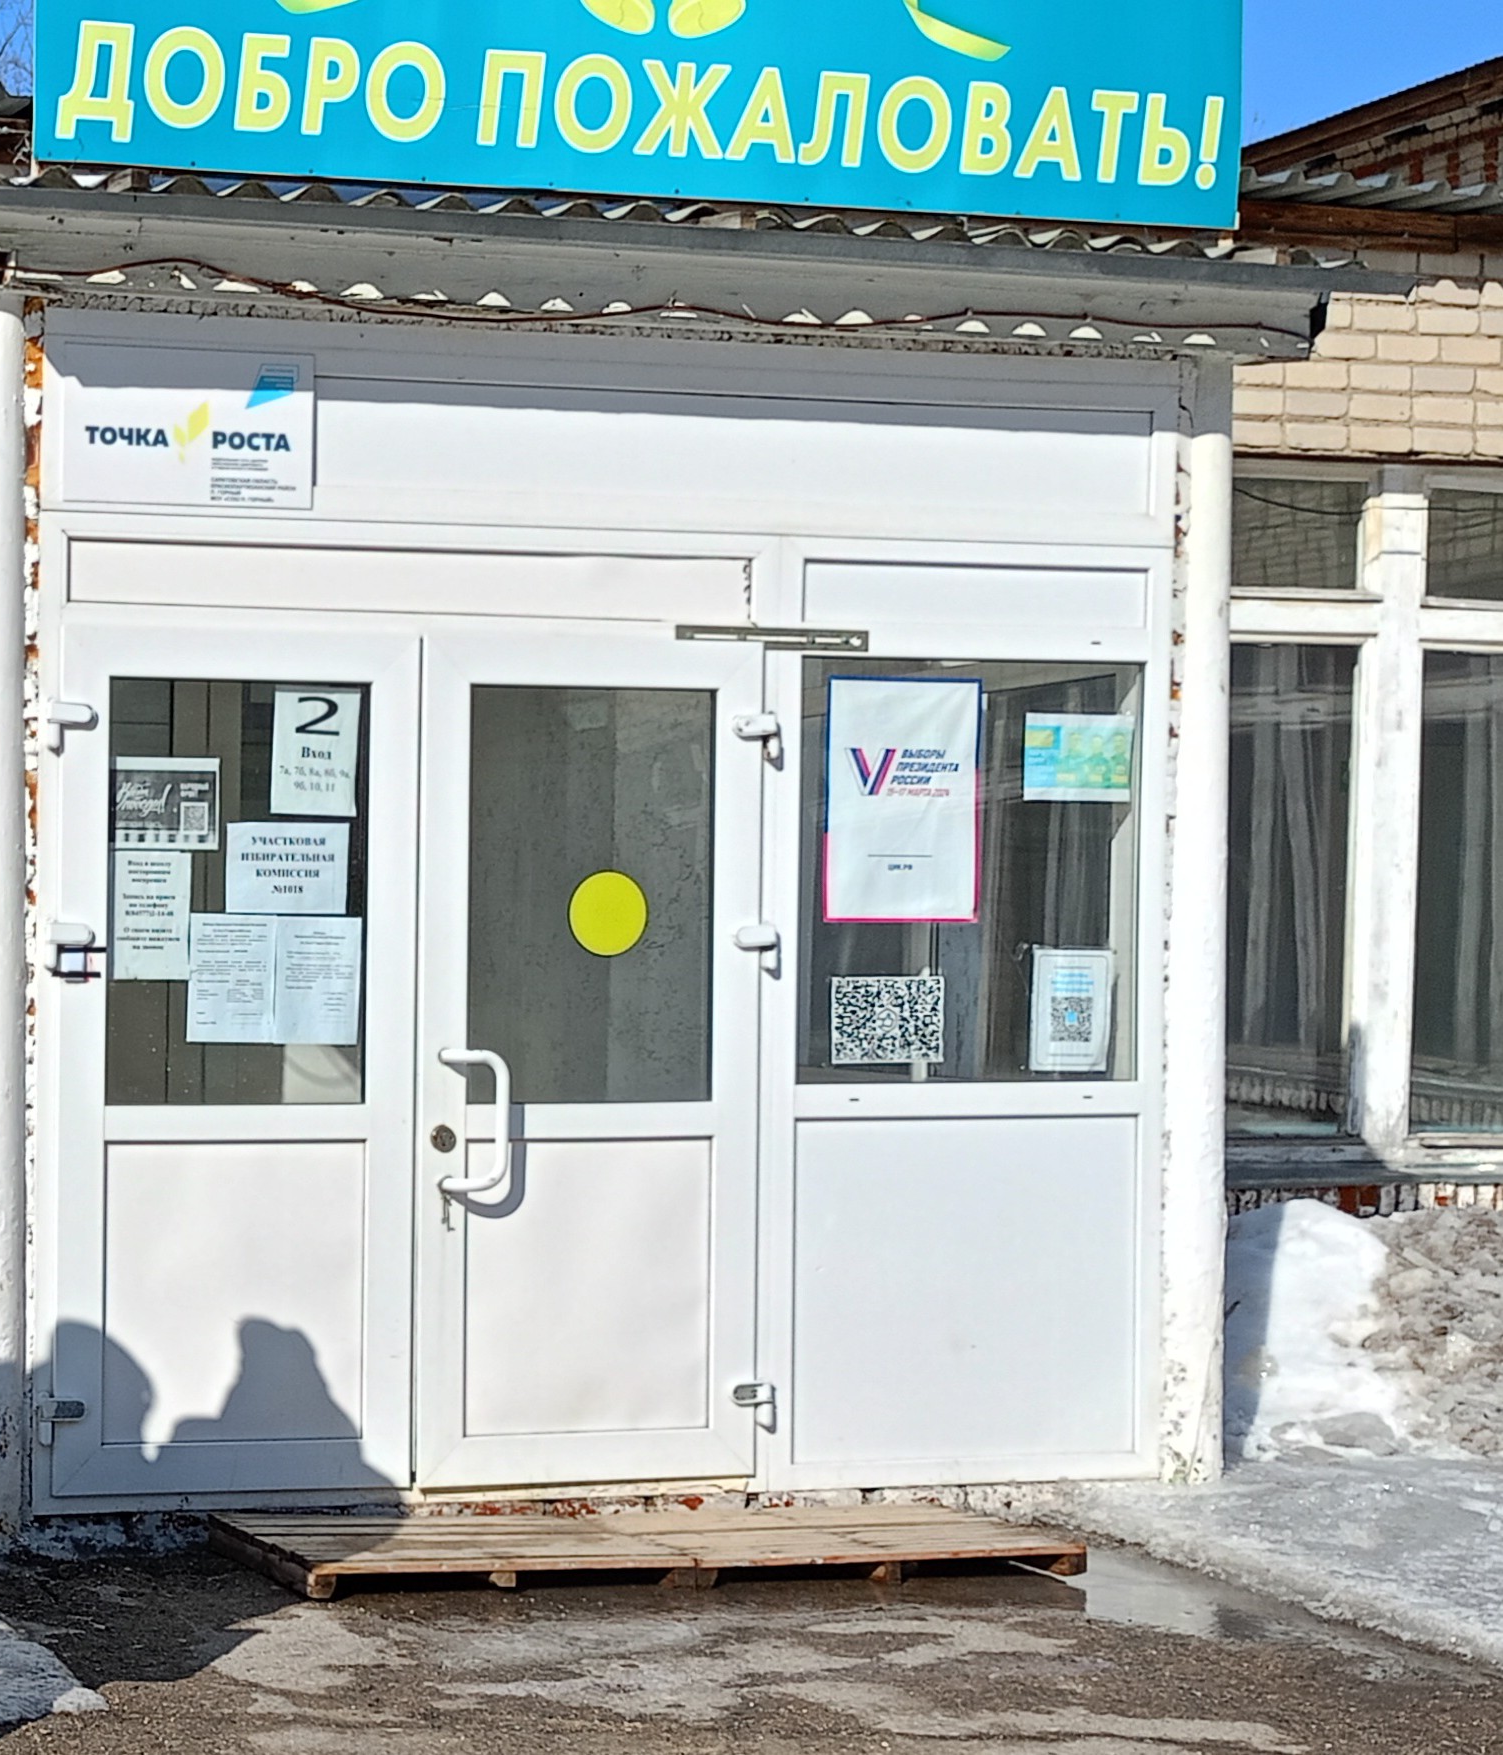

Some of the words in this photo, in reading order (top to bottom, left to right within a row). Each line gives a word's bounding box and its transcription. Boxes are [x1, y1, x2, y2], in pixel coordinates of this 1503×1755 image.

[54, 19, 446, 143] ДОБРО
[475, 48, 1225, 190] ПОЖАЛОВАТЬ!
[85, 426, 169, 448] ТОЧКА
[212, 431, 291, 452] РОСТА
[294, 696, 340, 736] 2
[301, 746, 332, 760] Вход
[901, 749, 946, 759] ВЫБОРЫ
[895, 762, 959, 773] ПРЕЗИДЕНТА
[890, 775, 932, 785] РОССИИ
[251, 836, 326, 846] УЧАСТКОВАЯ
[241, 852, 335, 863] ИЗБИРАТЕЛЬНАЯ
[255, 868, 320, 878] КОМИССИЯ
